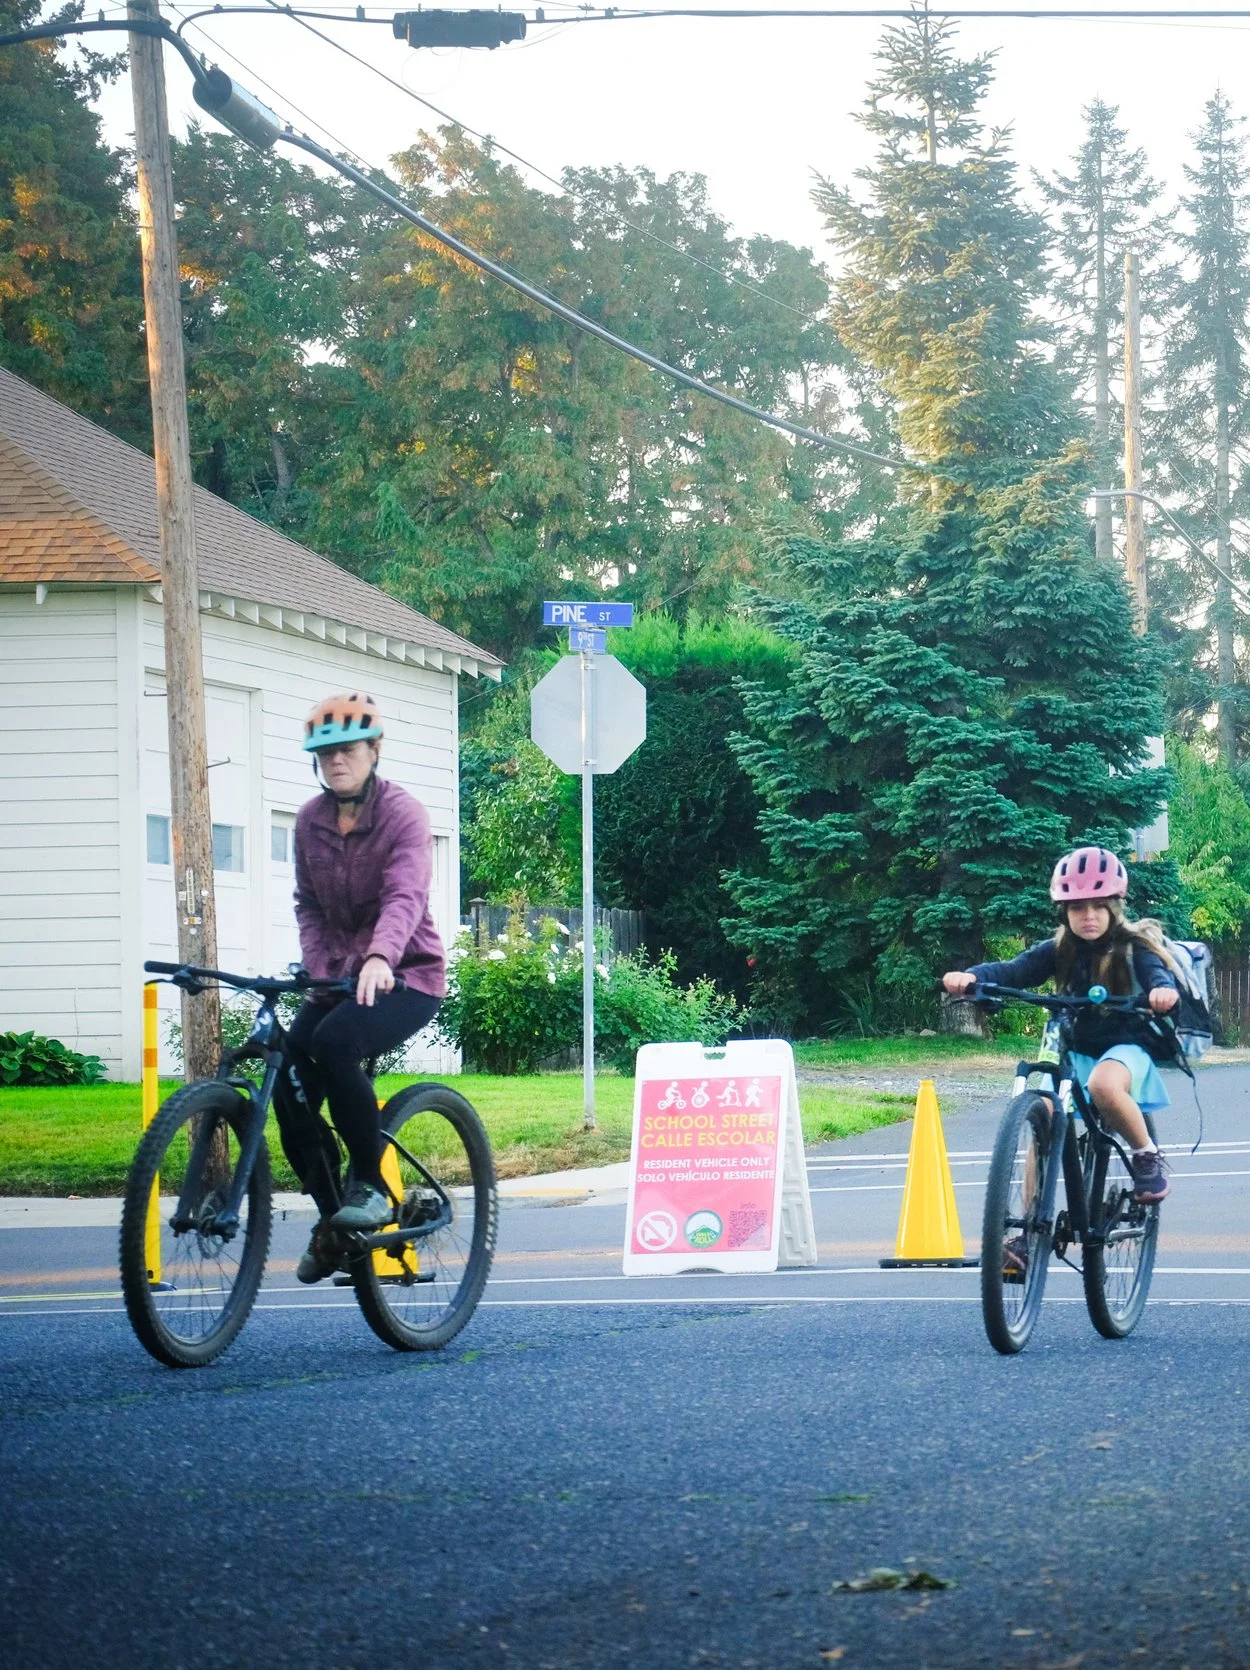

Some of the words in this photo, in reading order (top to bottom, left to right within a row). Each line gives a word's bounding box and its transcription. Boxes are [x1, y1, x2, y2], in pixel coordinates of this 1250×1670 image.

[552, 605, 587, 622] PINE
[599, 612, 611, 621] ST
[644, 1115, 716, 1130] SCHOOL
[721, 1113, 775, 1129] STREET
[640, 1132, 692, 1148] CALLE
[697, 1130, 776, 1146] ESCOLAR
[643, 1159, 692, 1170] RESIDENT
[694, 1157, 738, 1168] VEHICLE
[741, 1157, 770, 1167] ONLY
[637, 1173, 666, 1183] SOLO
[669, 1170, 720, 1182] VEHÍCULO
[723, 1170, 775, 1180] RESIDENTE
